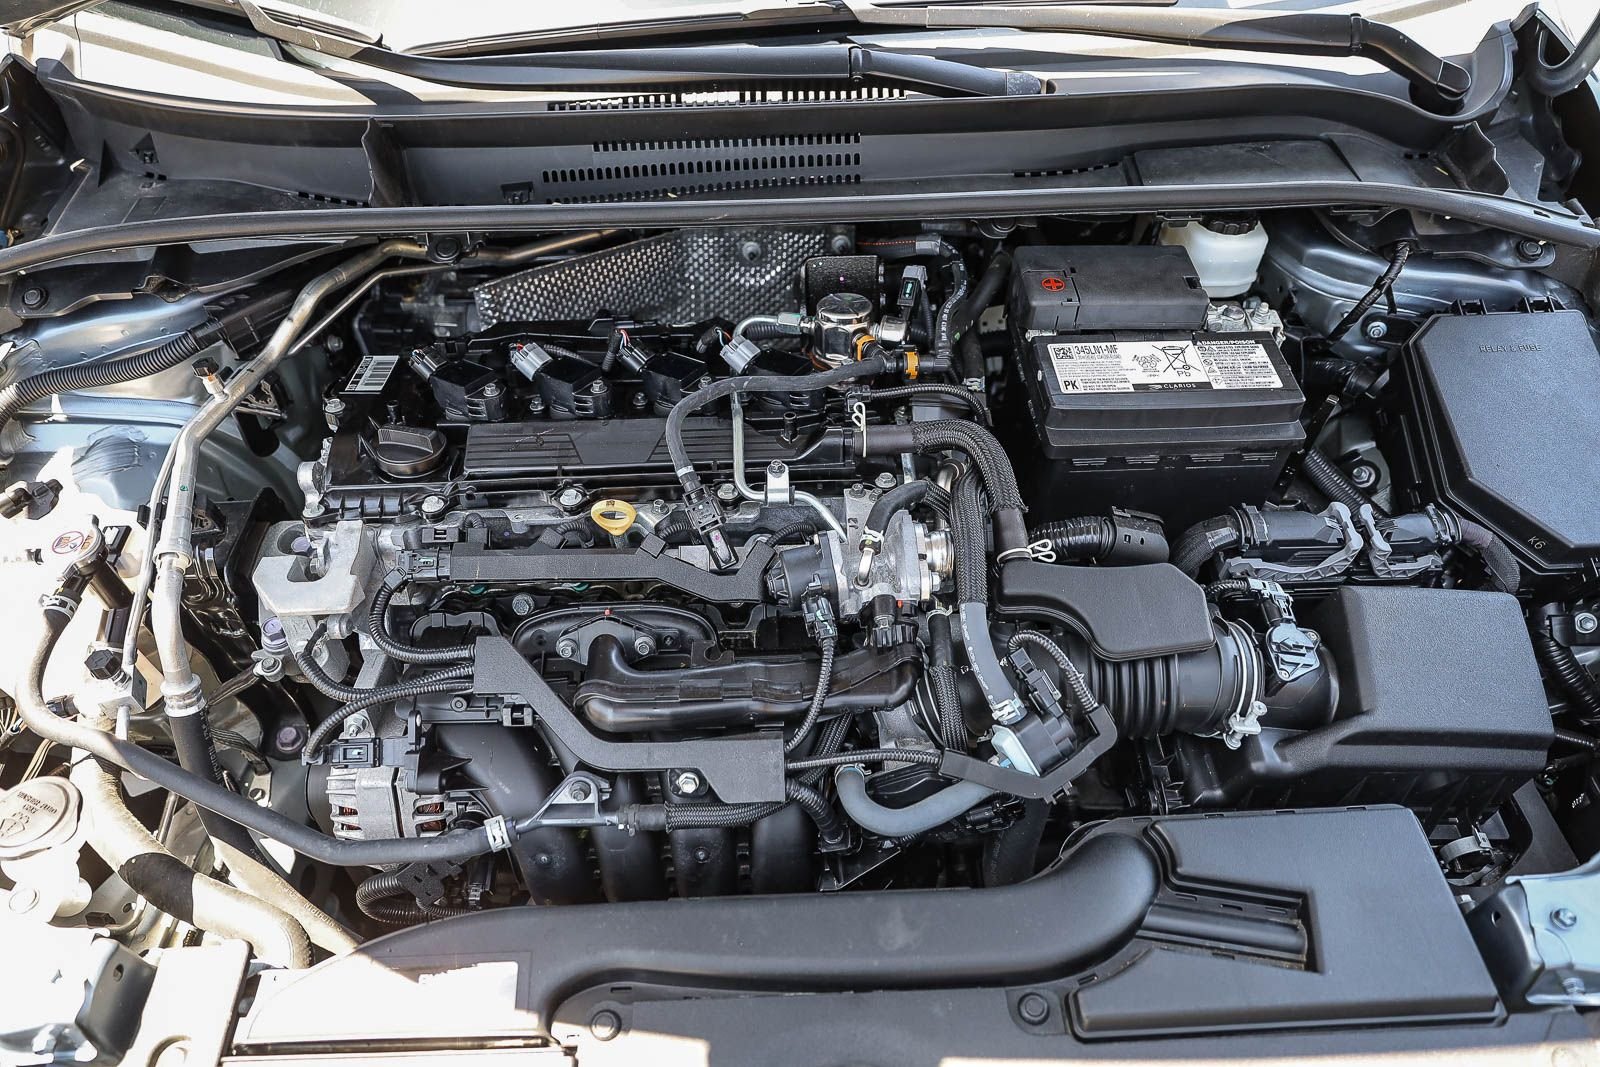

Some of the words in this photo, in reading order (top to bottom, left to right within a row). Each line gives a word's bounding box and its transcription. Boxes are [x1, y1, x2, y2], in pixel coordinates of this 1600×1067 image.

[1074, 344, 1119, 355] 345LN1-MF
[1479, 344, 1507, 353] RELAY
[1518, 343, 1542, 352] FUSE
[1063, 379, 1079, 391] PK
